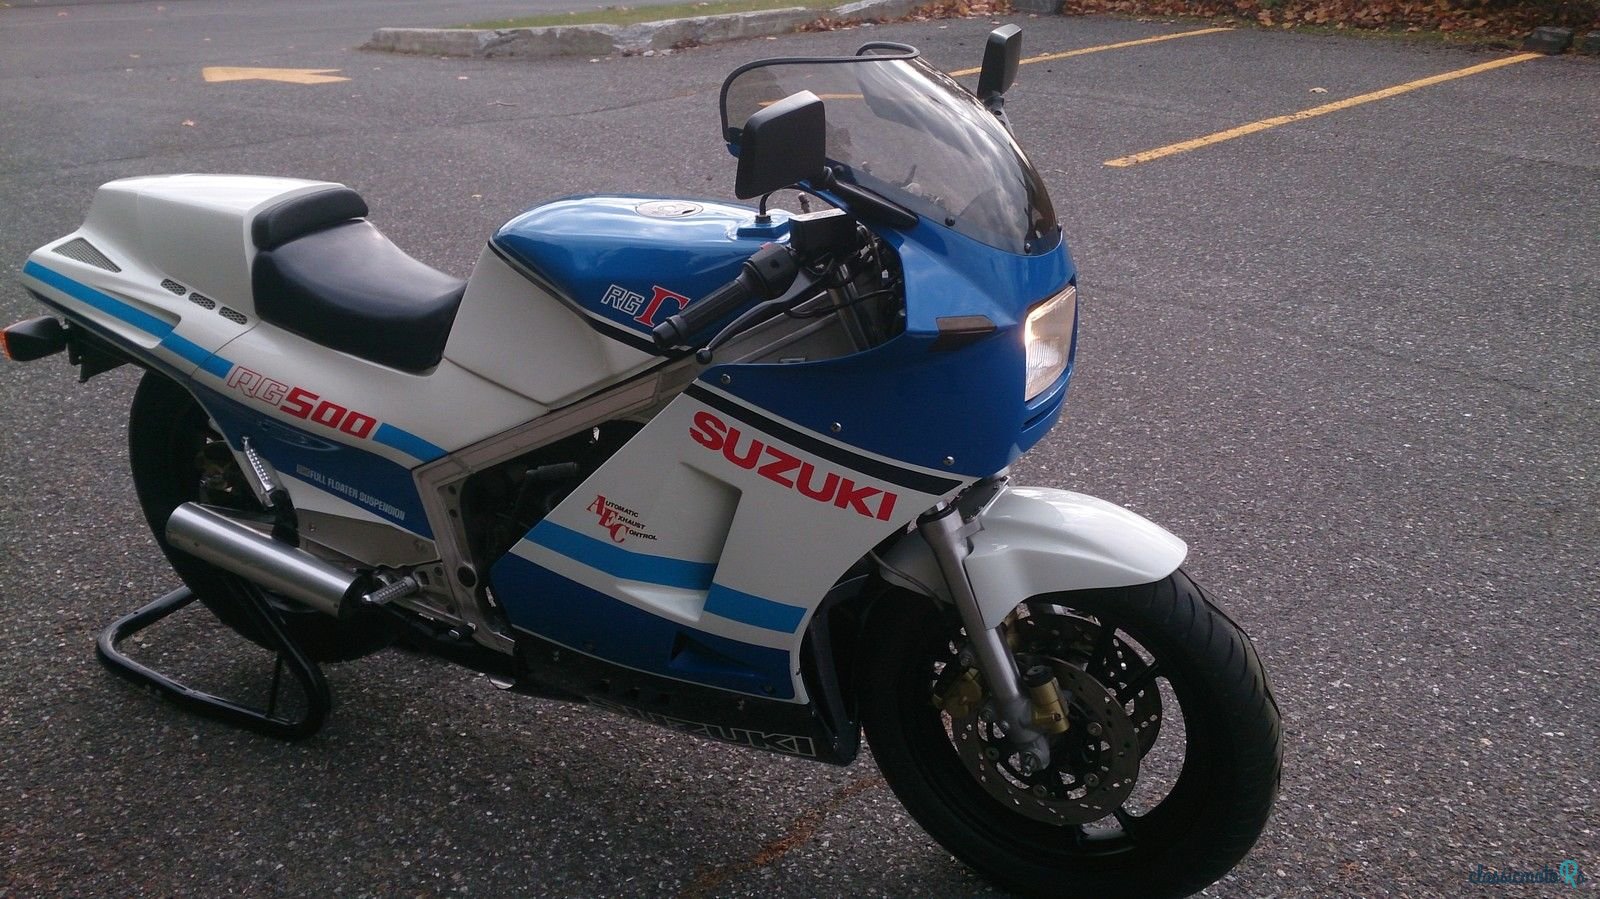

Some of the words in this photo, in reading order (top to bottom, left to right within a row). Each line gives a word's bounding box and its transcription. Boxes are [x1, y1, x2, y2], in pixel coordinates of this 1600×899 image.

[227, 366, 376, 439] RG500
[310, 470, 326, 485] FULL
[328, 478, 358, 499] FLOATER
[359, 491, 405, 521] SUSPENSION
[690, 411, 897, 521] SUZUKI
